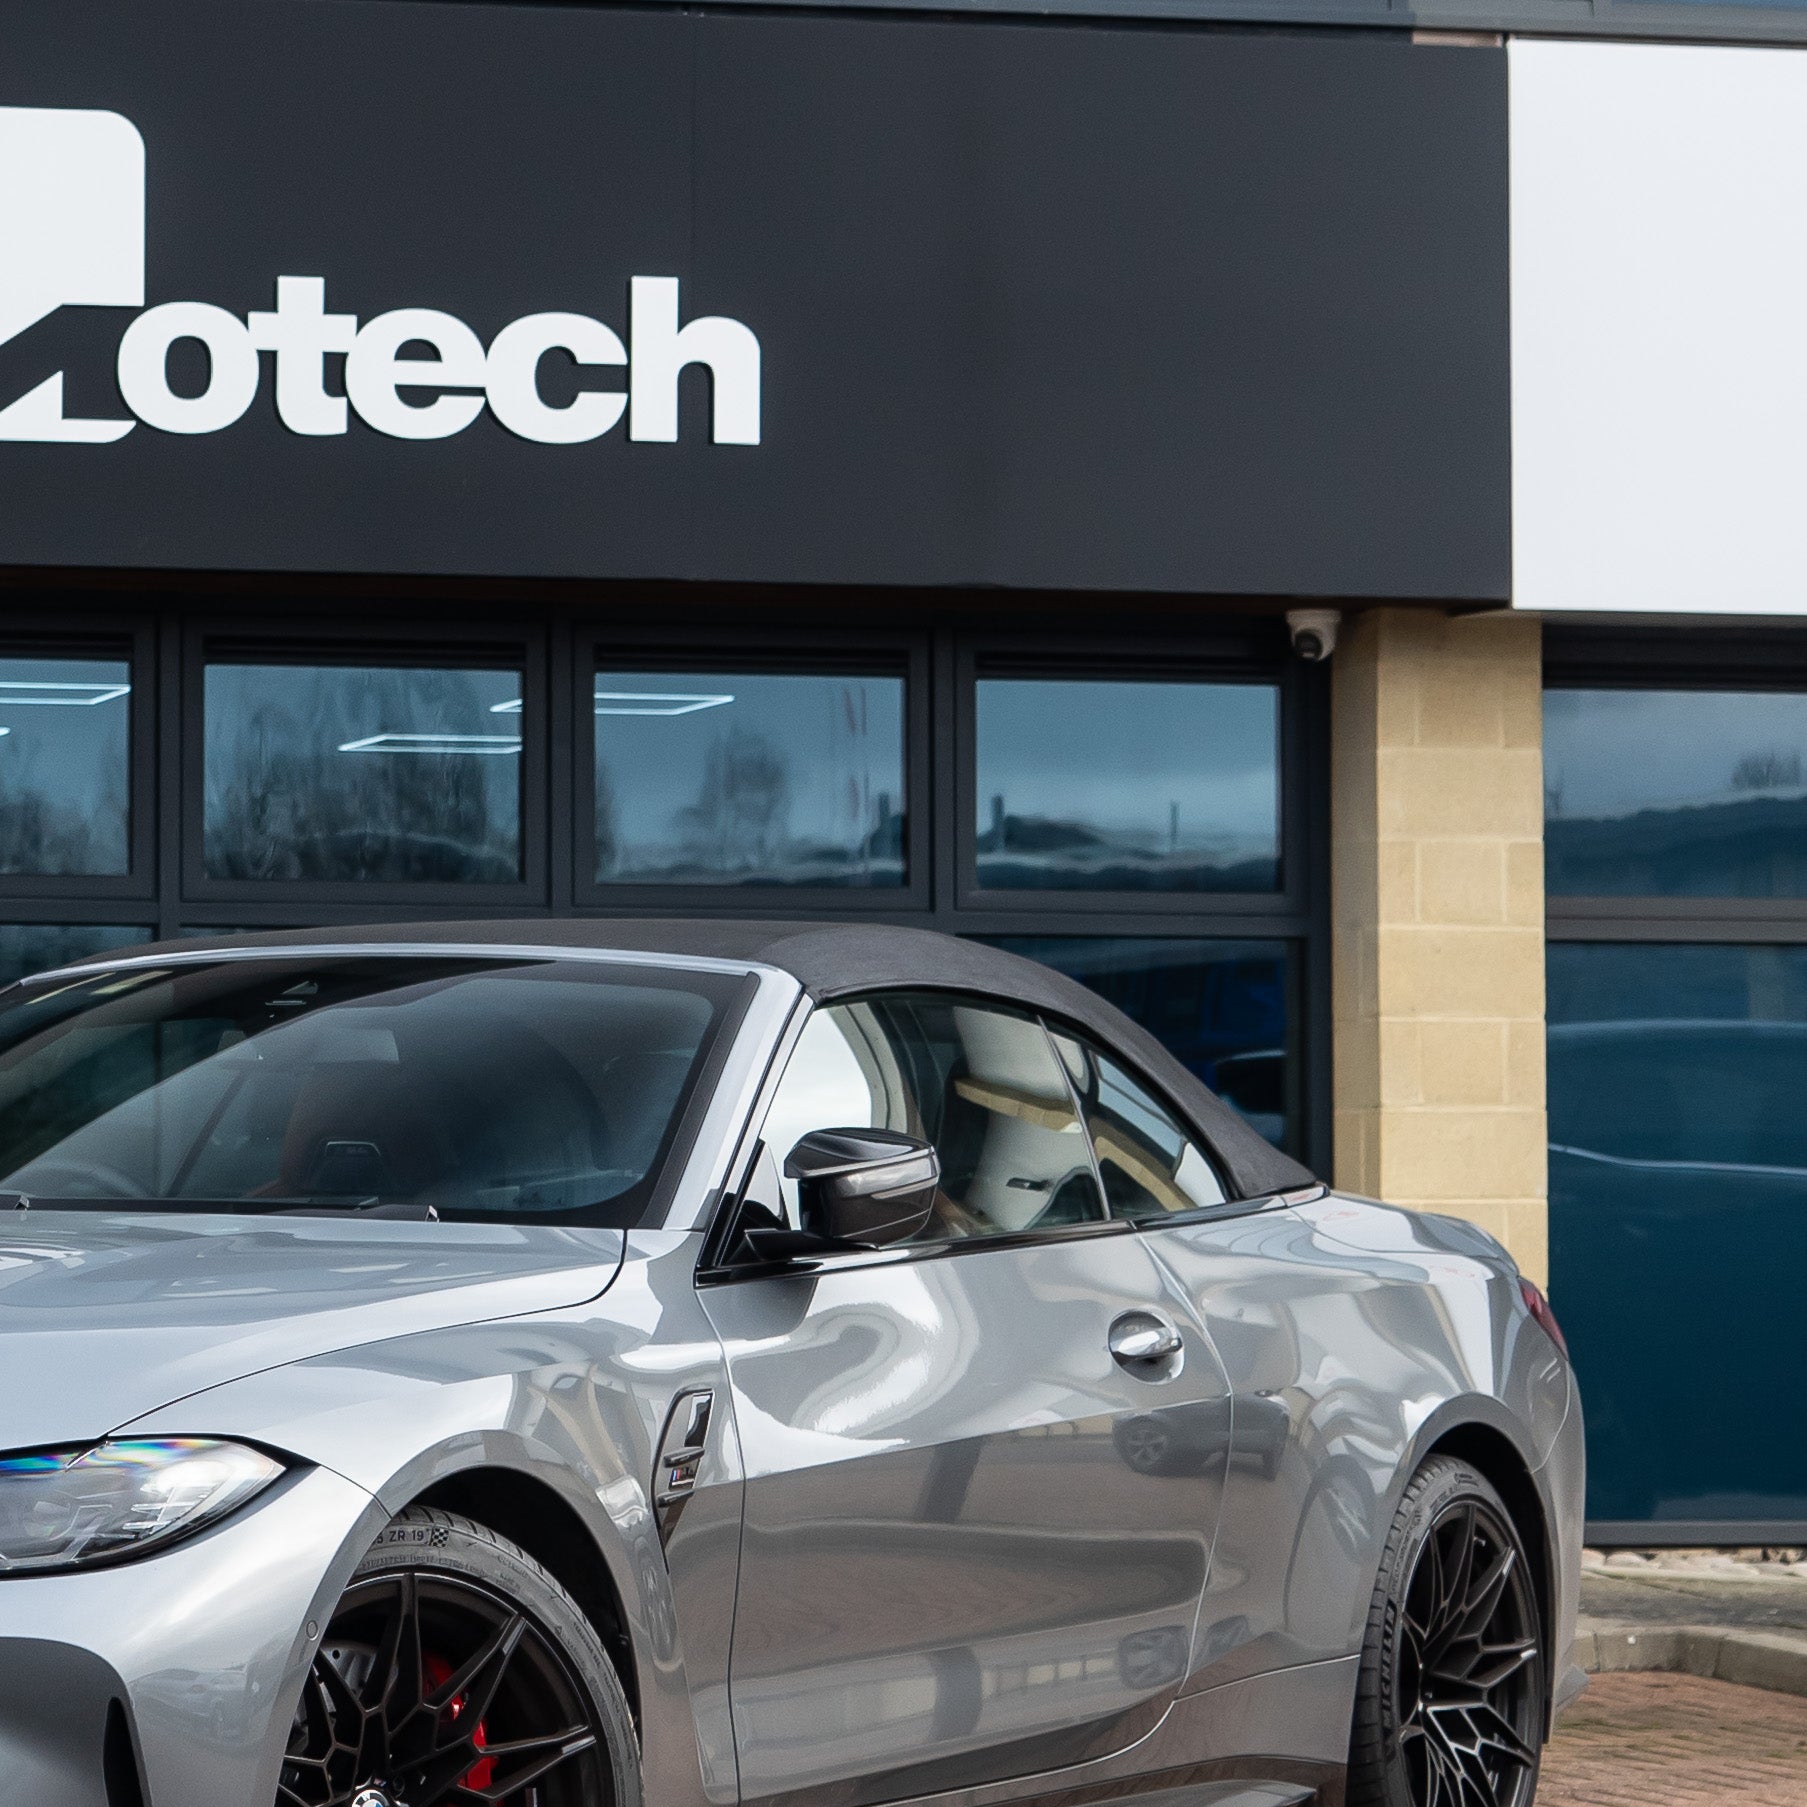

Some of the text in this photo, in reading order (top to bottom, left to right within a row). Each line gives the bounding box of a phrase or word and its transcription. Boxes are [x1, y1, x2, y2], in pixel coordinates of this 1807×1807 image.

[389, 1530, 405, 1542] ZR
[411, 1530, 424, 1541] 19
[1380, 1606, 1395, 1729] MICHELIN
